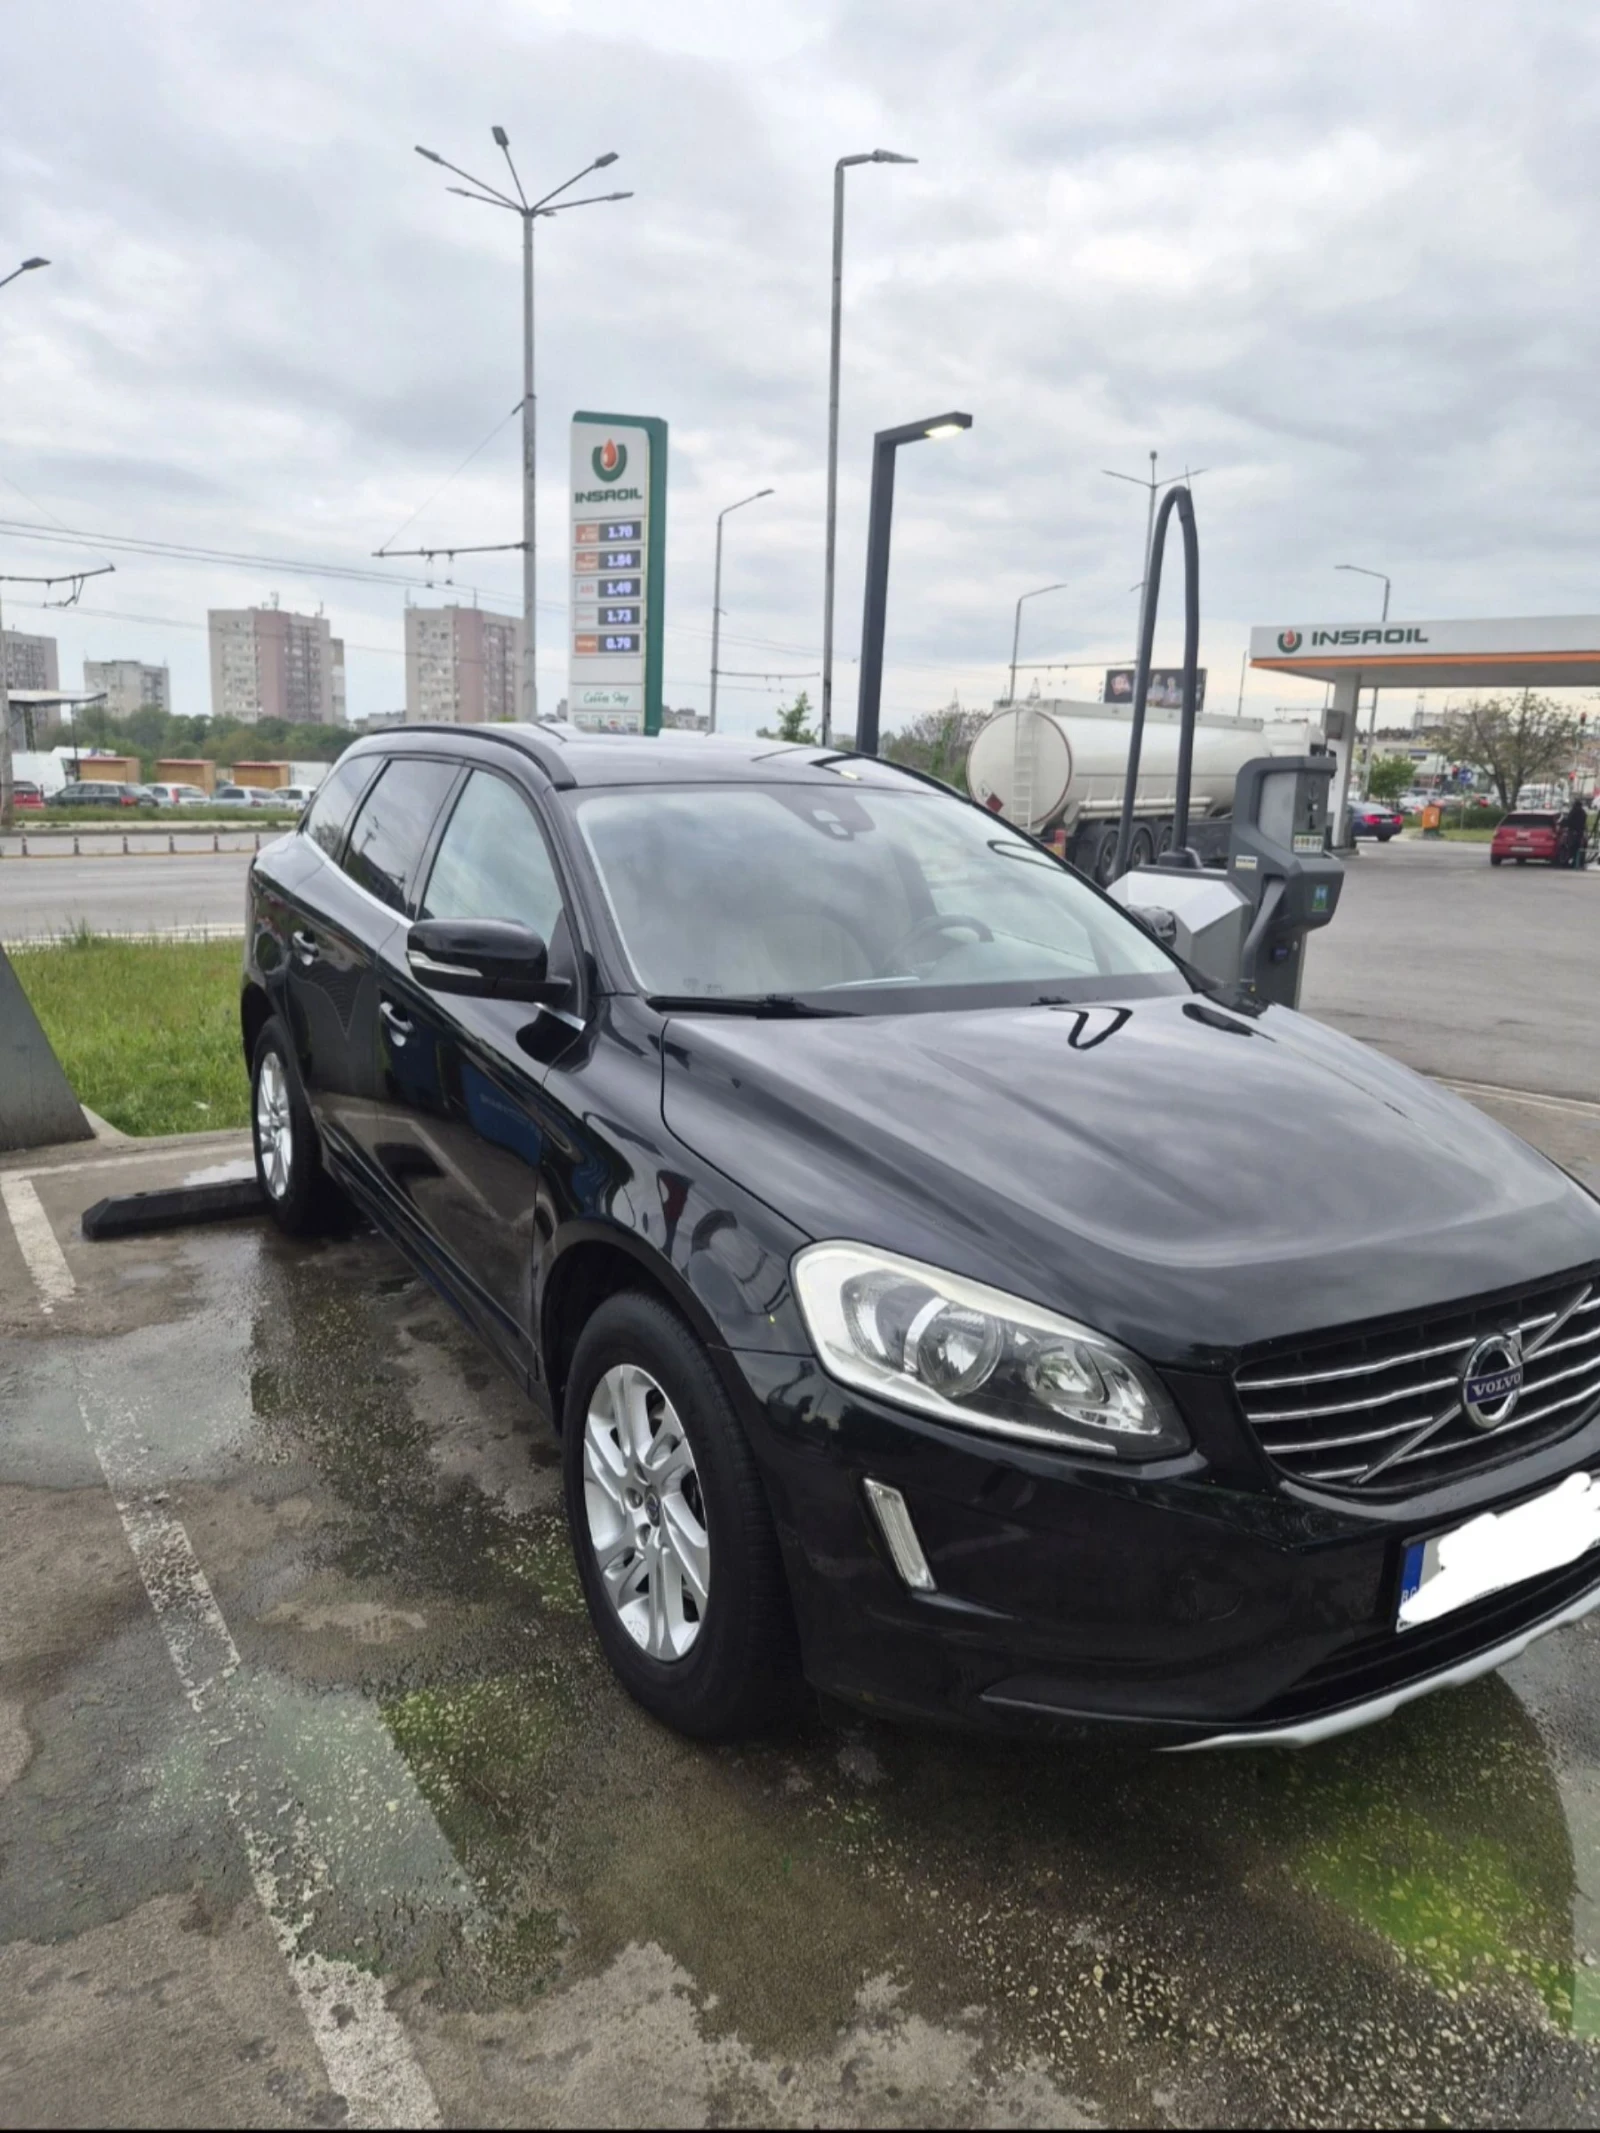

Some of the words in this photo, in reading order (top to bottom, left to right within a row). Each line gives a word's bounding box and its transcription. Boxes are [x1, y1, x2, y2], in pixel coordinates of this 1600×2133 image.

[574, 487, 643, 504] INSAOIL
[1311, 628, 1429, 646] INSAOIL
[1471, 1371, 1521, 1397] VOLVO
